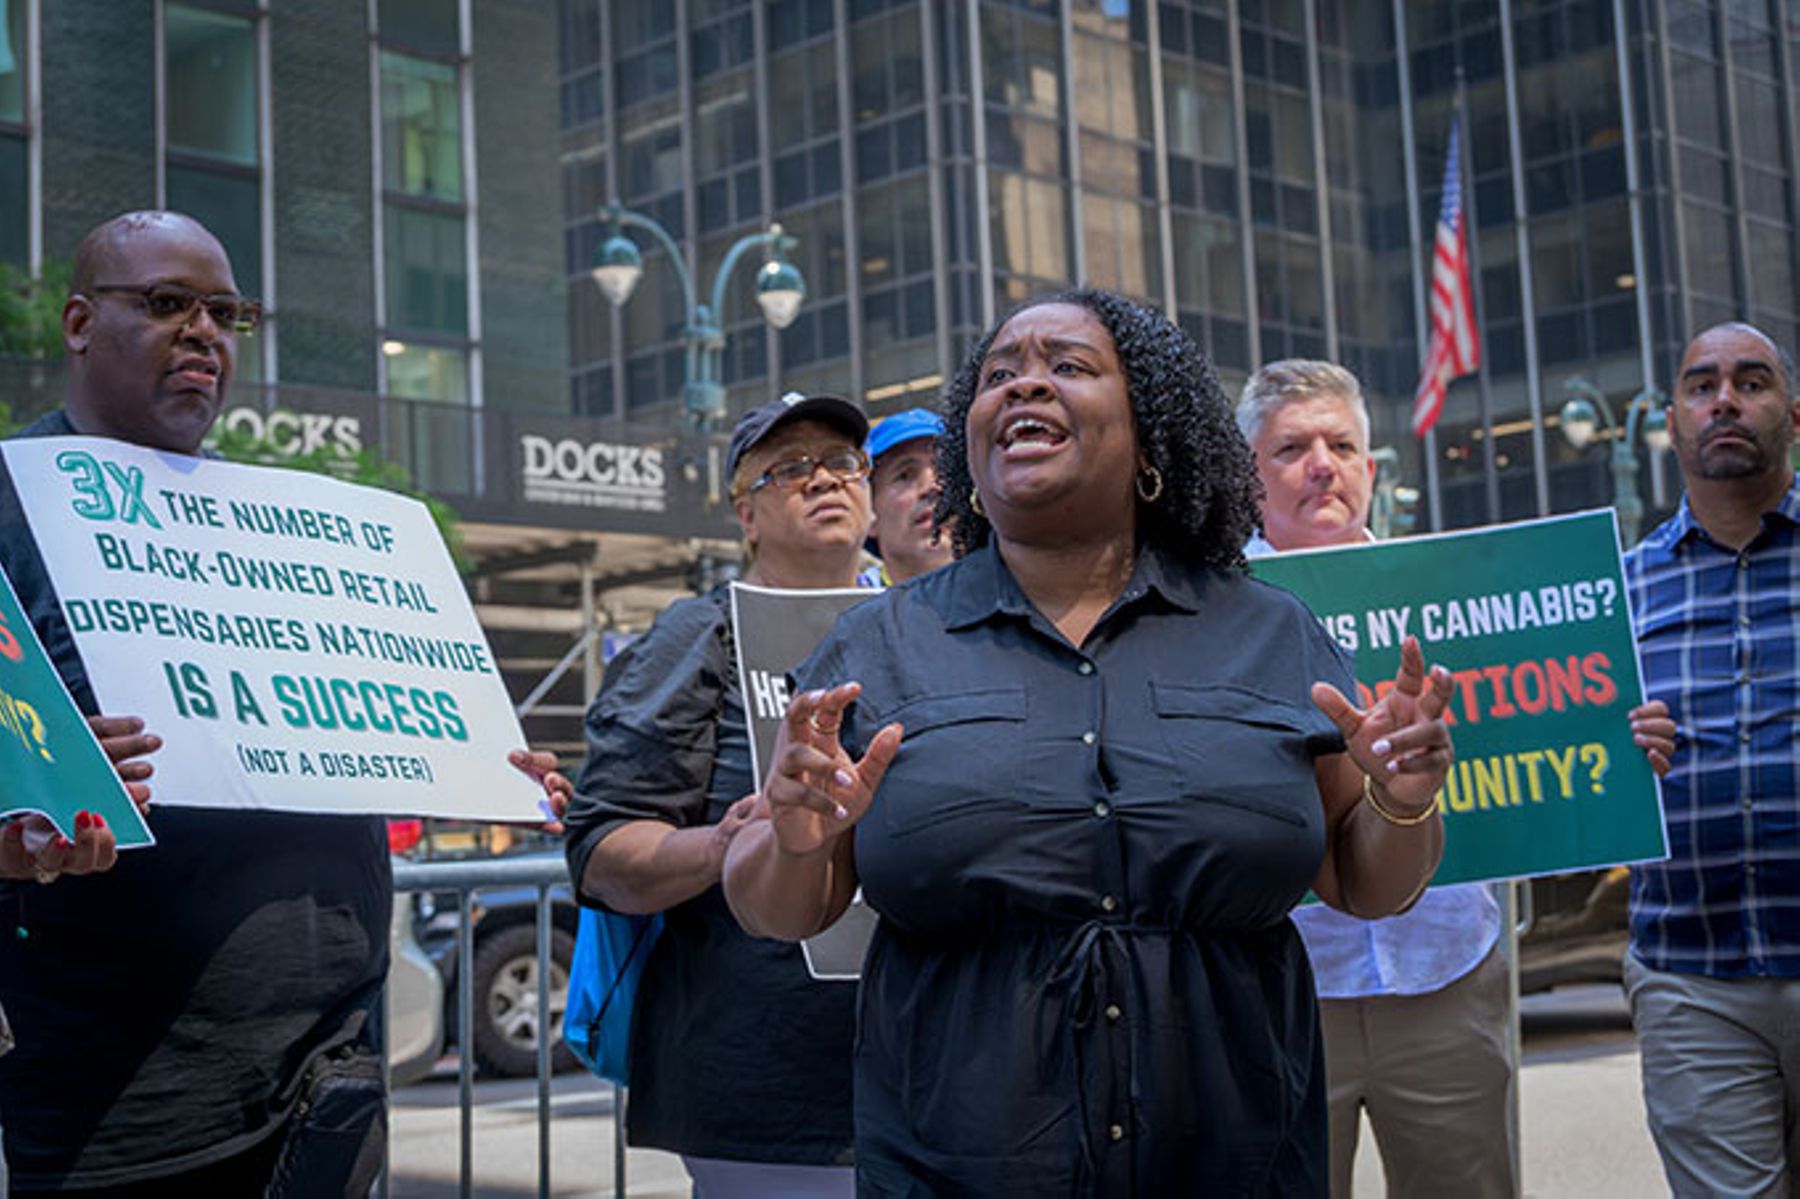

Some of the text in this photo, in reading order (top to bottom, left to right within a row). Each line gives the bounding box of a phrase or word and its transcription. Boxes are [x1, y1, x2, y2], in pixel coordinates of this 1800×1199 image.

[203, 408, 362, 458] OCKS
[522, 435, 665, 487] DOCKS
[56, 451, 394, 553] 3X THE NUMBER OF
[95, 532, 439, 614] BLACK-OWNED RETAIL
[64, 600, 310, 652] DISPENSARIES
[315, 621, 494, 675] NATIONWIDE
[1366, 606, 1410, 649] NY
[1421, 578, 1617, 642] CANNABIS?
[163, 661, 469, 742] IS A SUCCESS
[236, 744, 434, 783] (NOT A DISASTER)
[1435, 742, 1610, 815] UNITY?
